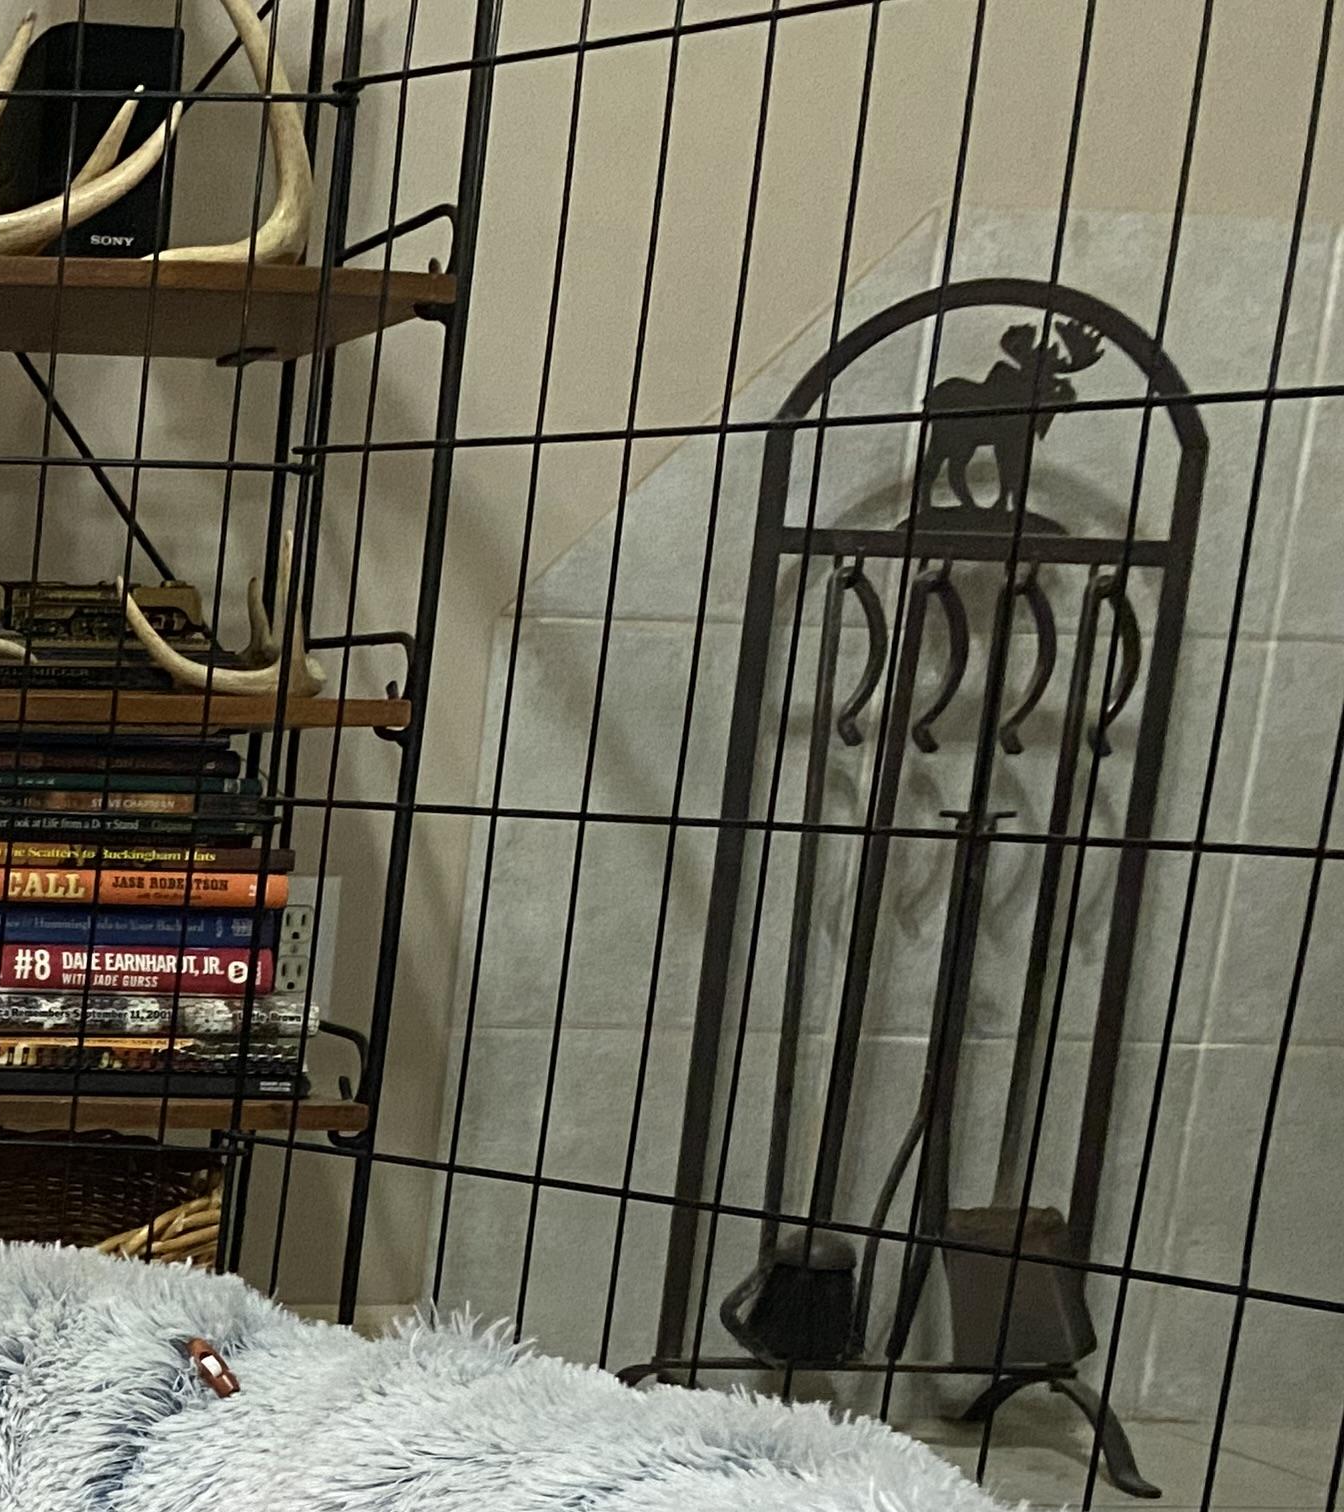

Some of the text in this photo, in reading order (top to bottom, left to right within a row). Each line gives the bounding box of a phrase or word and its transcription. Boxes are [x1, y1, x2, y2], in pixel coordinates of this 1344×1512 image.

[90, 234, 135, 247] SONY
[91, 798, 121, 808] STVE
[42, 817, 59, 829] Life
[92, 818, 111, 830] Dr
[82, 848, 96, 859] to
[102, 848, 181, 863] Buckingham
[8, 871, 85, 899] CALL
[112, 875, 229, 892] JASE ROBETSON
[156, 918, 205, 932] Backard
[14, 948, 51, 981] #8
[61, 951, 102, 971] DALE
[202, 956, 225, 975] JR.
[93, 974, 119, 986] JADE
[122, 974, 159, 988] GURSS
[73, 1009, 128, 1020] Sptember
[271, 1012, 302, 1023] Brown
